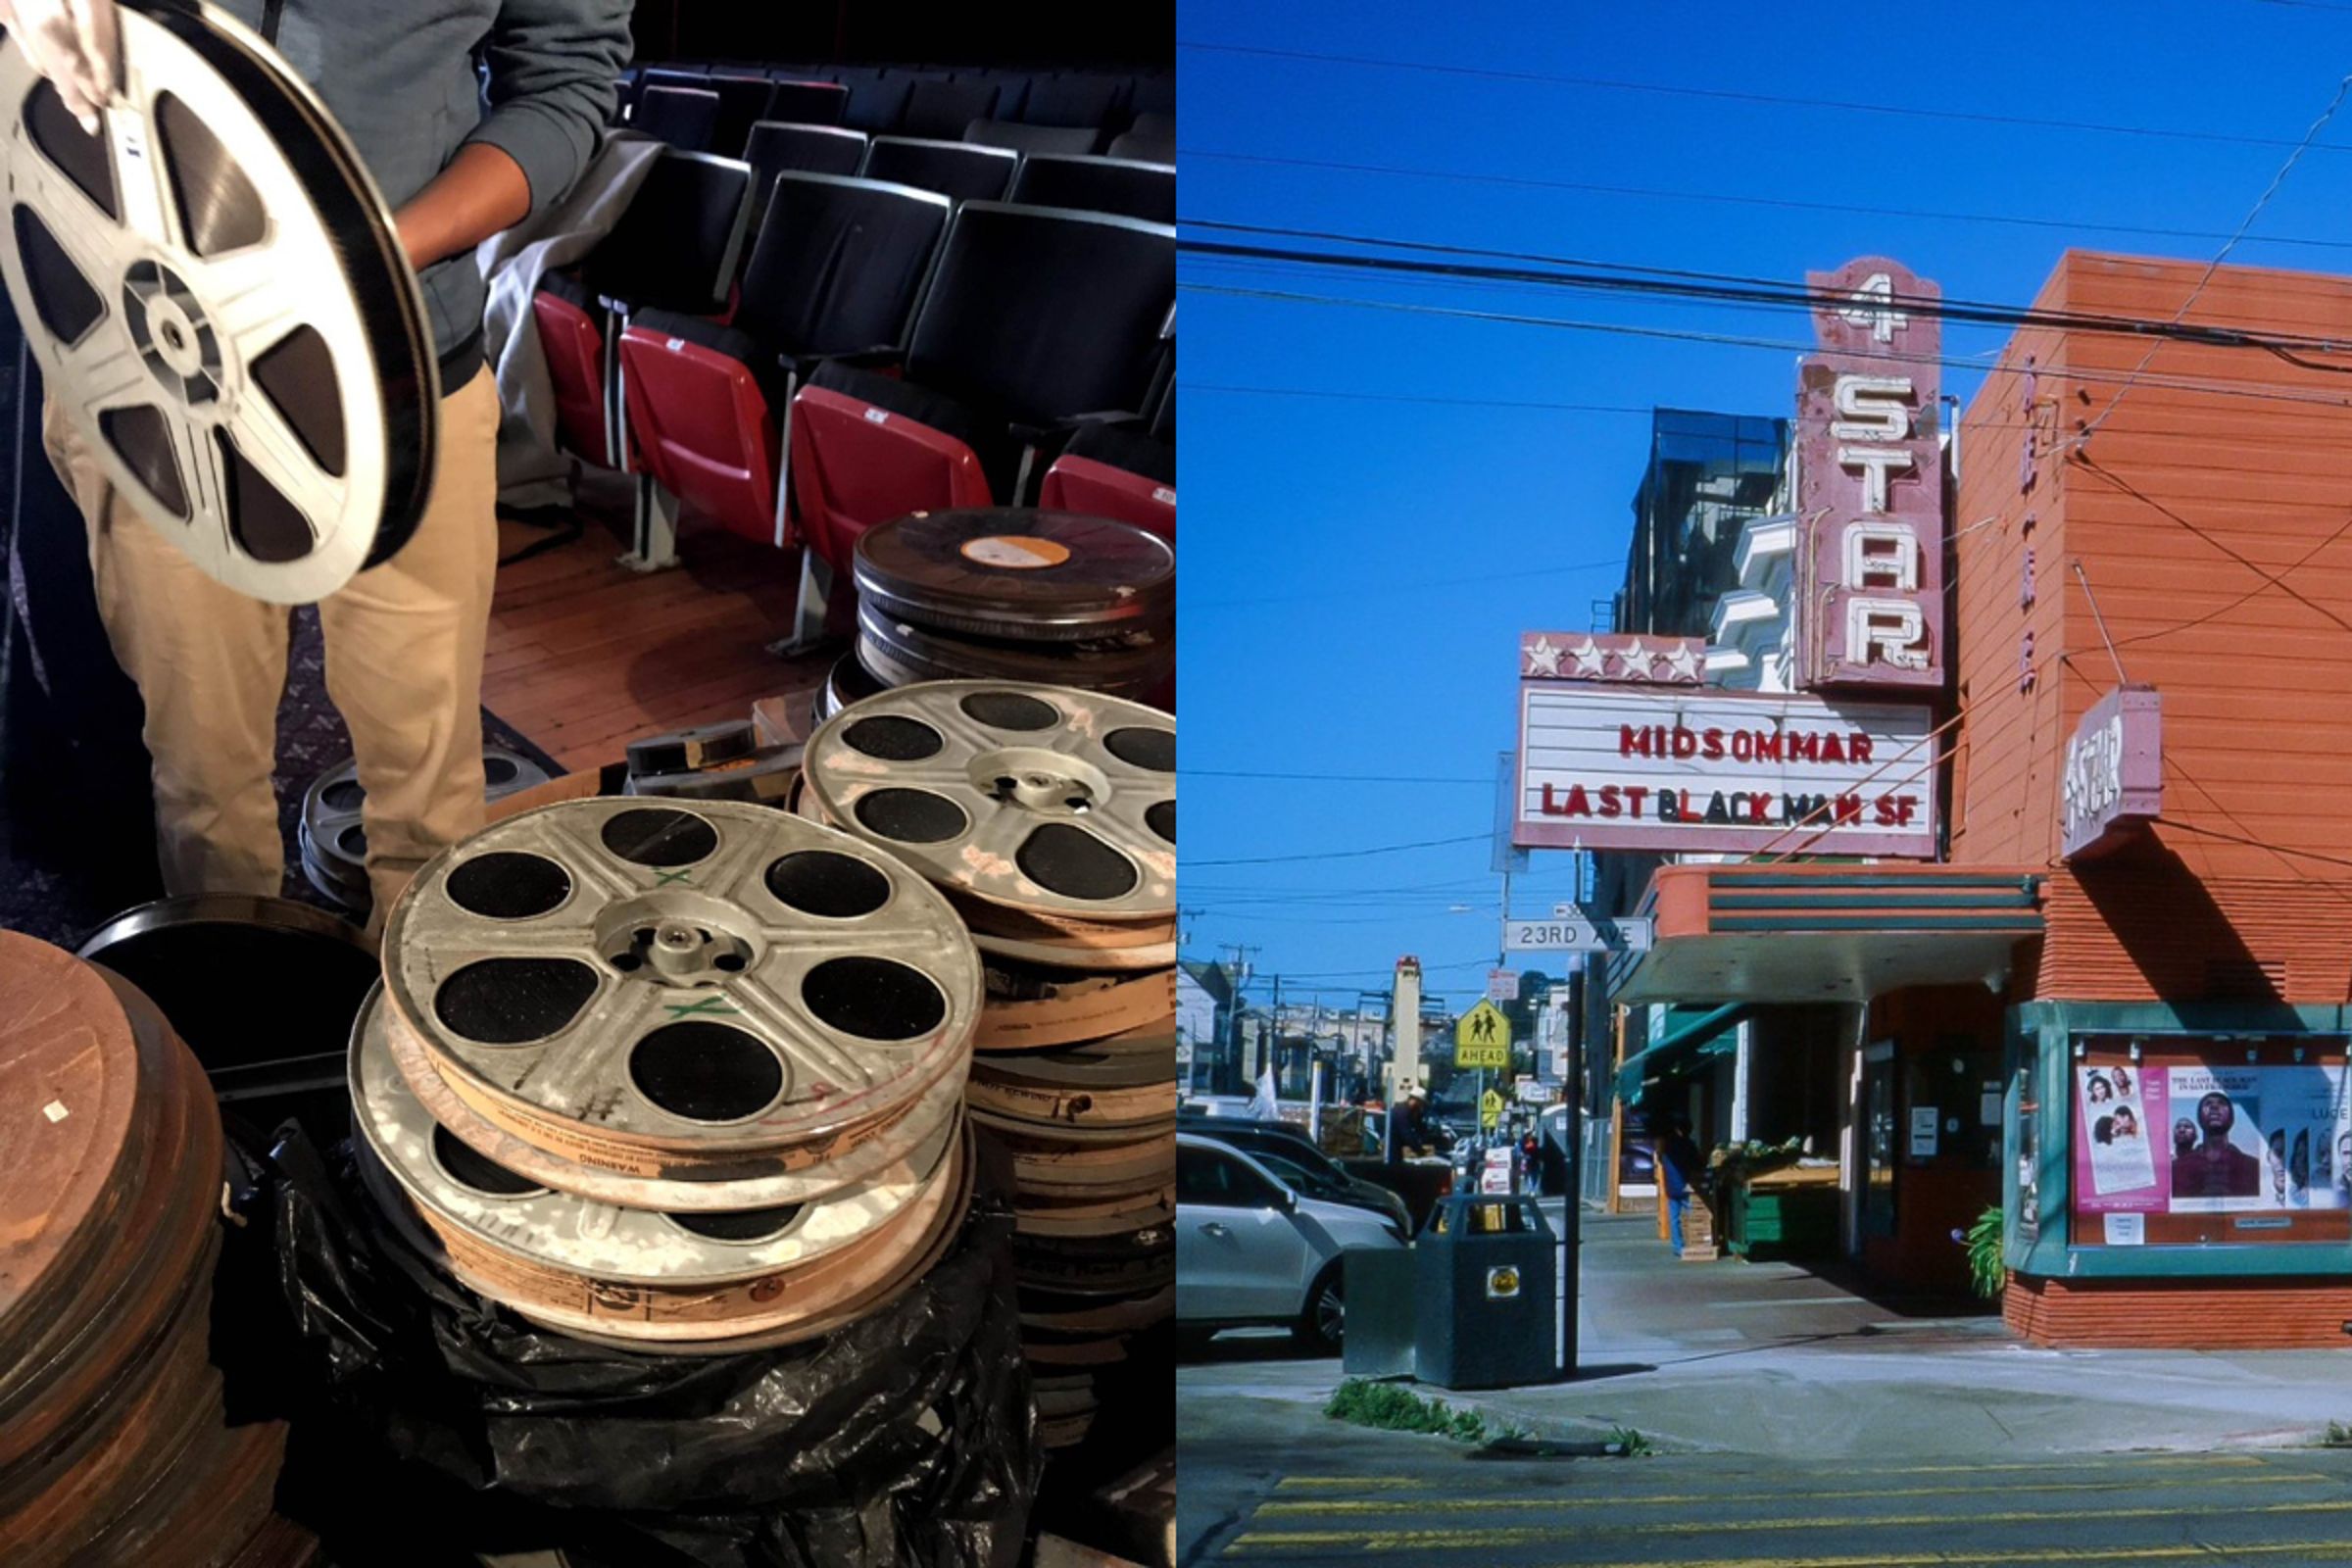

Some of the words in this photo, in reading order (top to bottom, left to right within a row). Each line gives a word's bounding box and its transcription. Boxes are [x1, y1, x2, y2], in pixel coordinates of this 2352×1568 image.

[1838, 273, 1908, 343] 4
[1831, 373, 1930, 670] STAR
[1619, 723, 1874, 764] MIDSOMMAR
[1542, 782, 1648, 819] LAST
[1657, 788, 1775, 824] BLACK
[1783, 792, 1861, 827] MAN
[1874, 795, 1918, 827] SF
[1520, 926, 1577, 944] 23RD
[1592, 926, 1633, 944] AVE
[1460, 1050, 1504, 1062] AHEAD
[579, 1153, 642, 1175] WARNING
